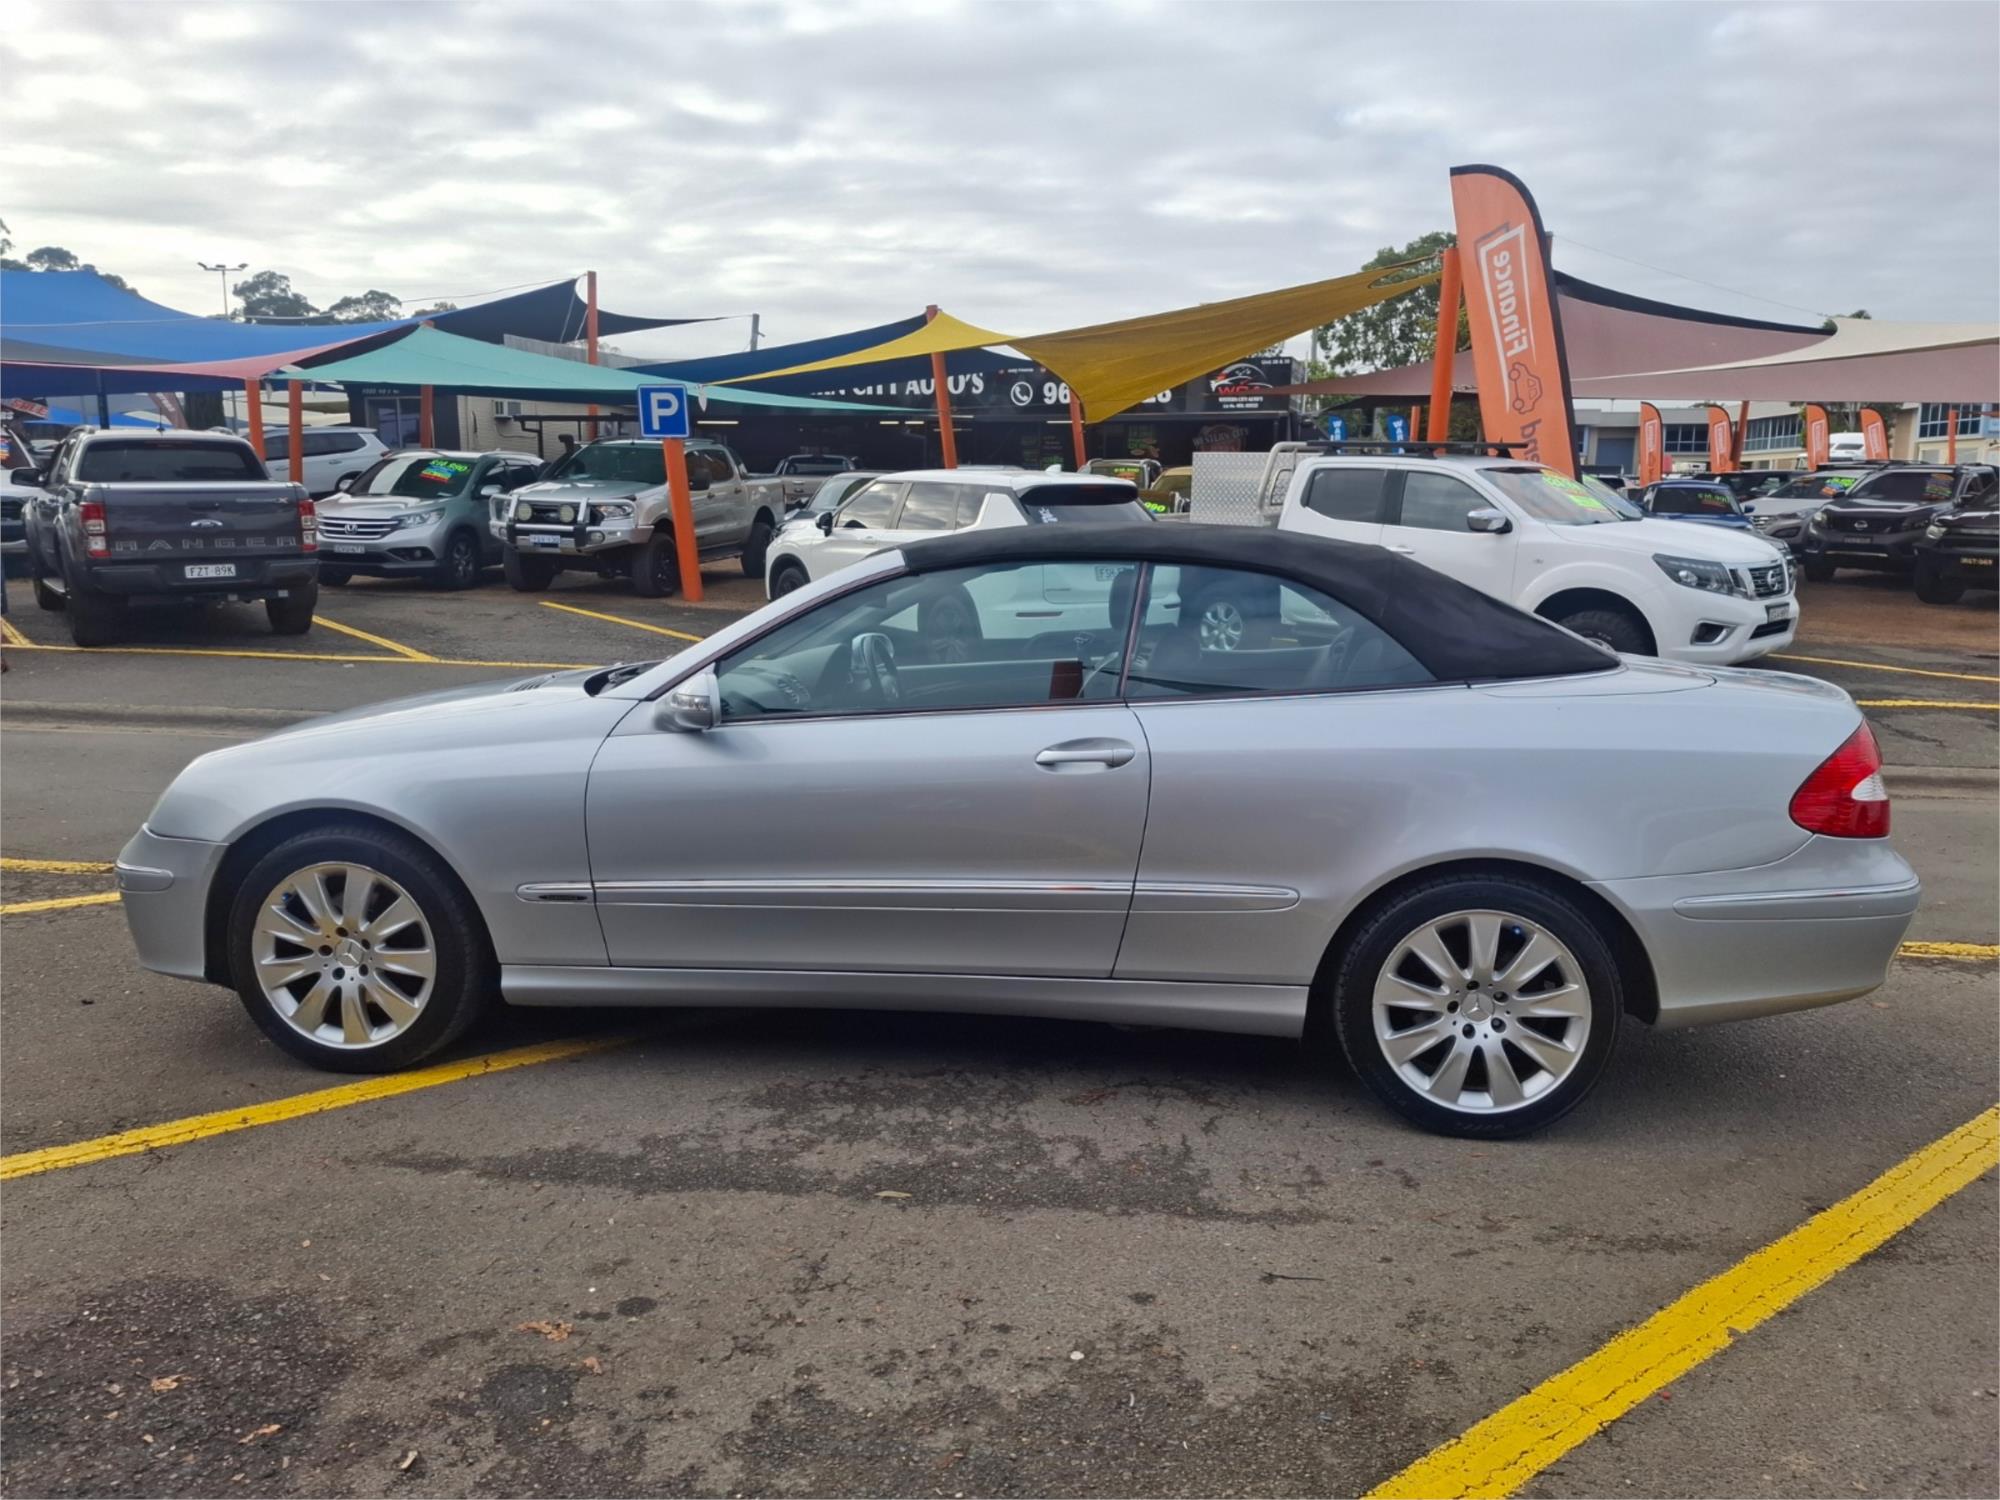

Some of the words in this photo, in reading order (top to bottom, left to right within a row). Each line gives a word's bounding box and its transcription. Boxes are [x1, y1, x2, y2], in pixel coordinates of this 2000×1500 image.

[905, 372, 985, 396] AUO'S
[650, 392, 679, 430] P
[115, 535, 297, 551] RANGER
